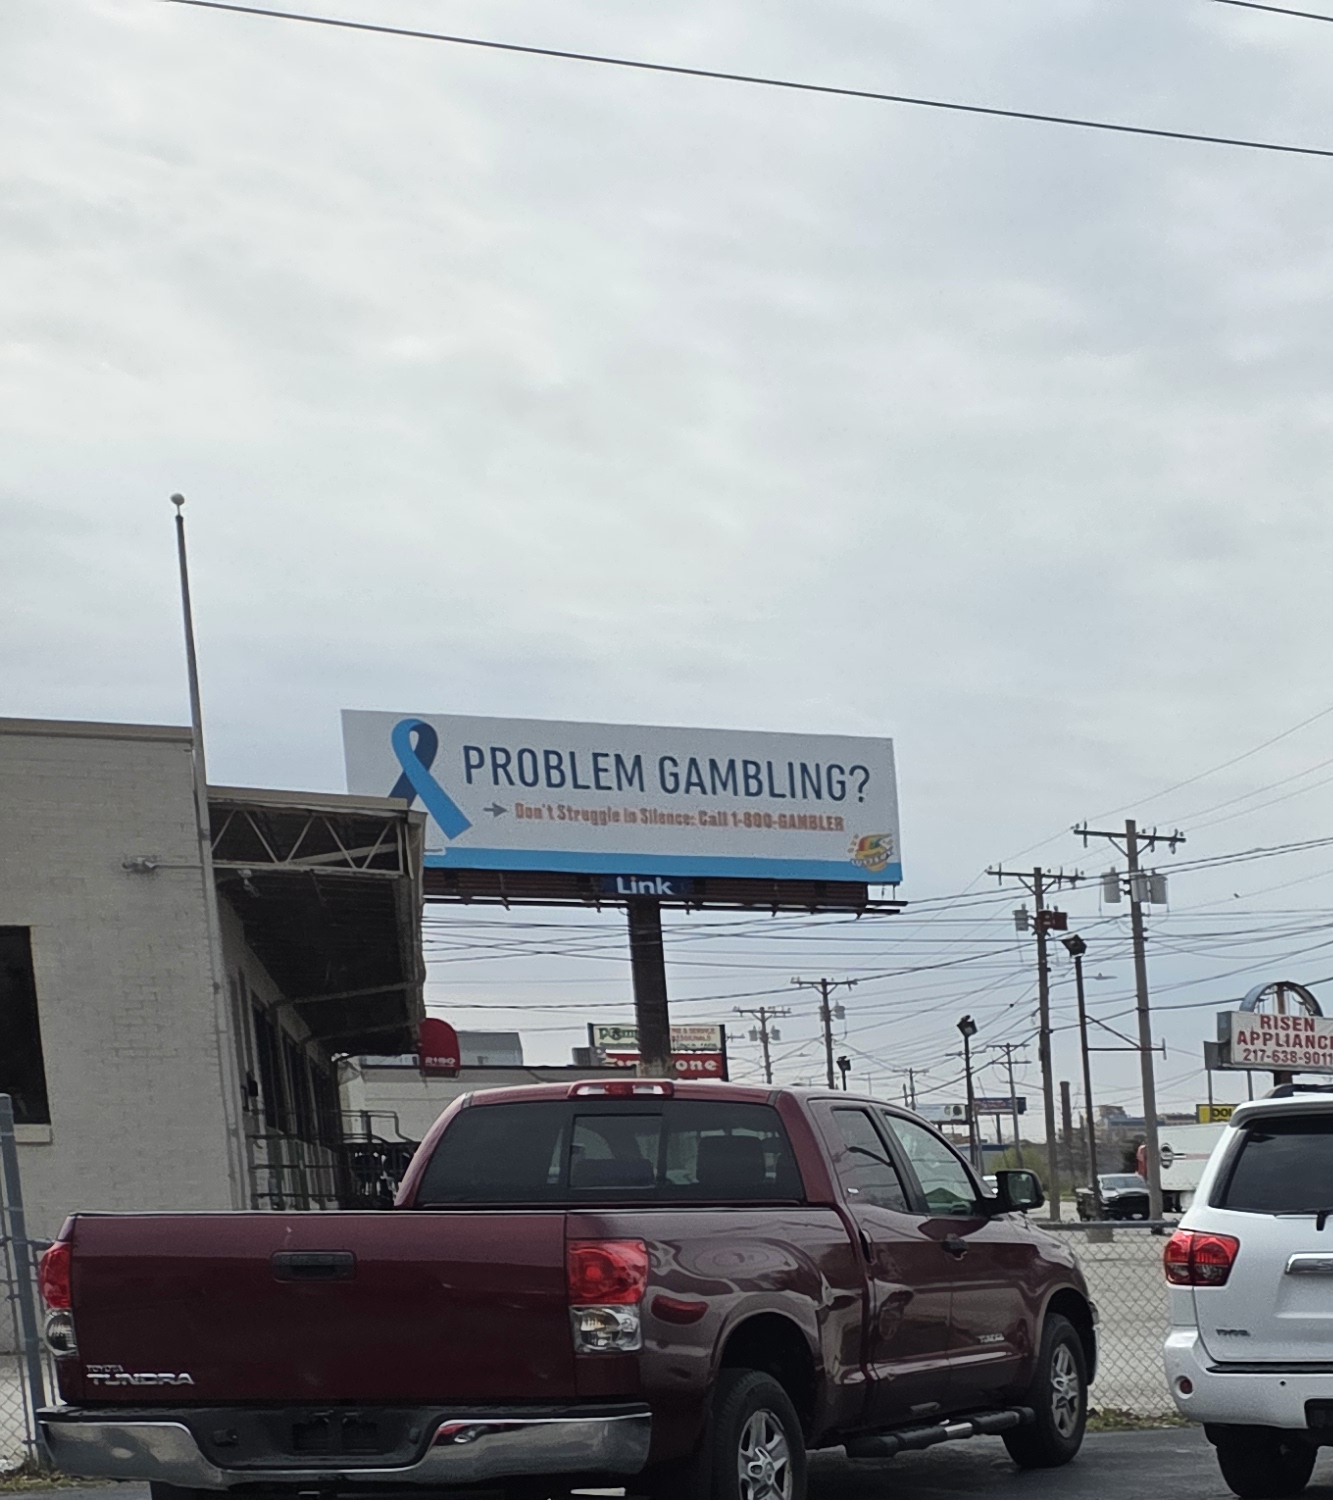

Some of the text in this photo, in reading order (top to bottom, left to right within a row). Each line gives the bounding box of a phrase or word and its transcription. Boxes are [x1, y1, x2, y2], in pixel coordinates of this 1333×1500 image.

[463, 745, 870, 803] PROBLEM GAMBLING?
[556, 803, 621, 826] Struggle
[698, 810, 728, 827] Call
[731, 811, 844, 832] 1-800-GAMBLER
[616, 876, 676, 895] Link
[1260, 1015, 1315, 1032] RISEN
[1243, 1048, 1333, 1066] 217-638-9011
[86, 1373, 195, 1386] TUNDRA
